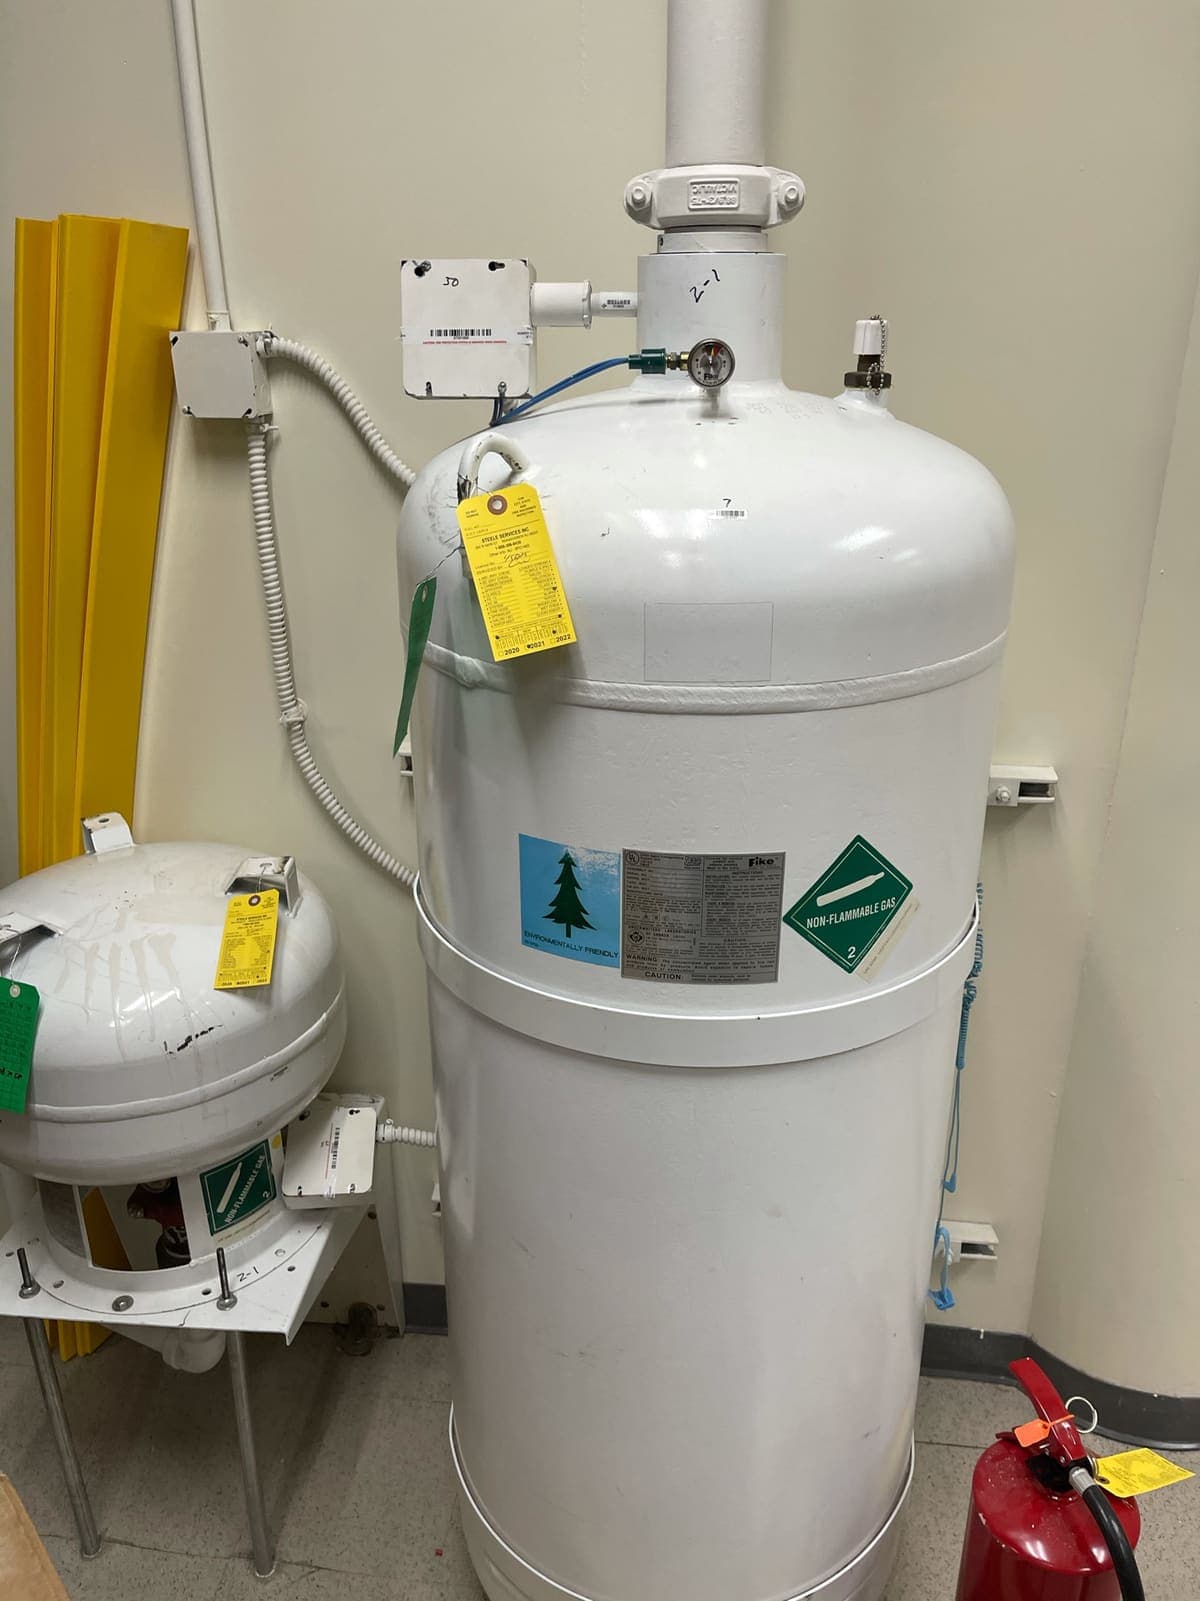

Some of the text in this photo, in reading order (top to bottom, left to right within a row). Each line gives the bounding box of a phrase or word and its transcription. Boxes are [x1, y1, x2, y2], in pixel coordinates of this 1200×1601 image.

[689, 269, 721, 304] 2-1
[722, 498, 732, 508] 7
[504, 647, 520, 656] 2020
[555, 633, 572, 643] 2022
[748, 856, 775, 867] Fike
[806, 896, 896, 929] NON-FLAMMABLE GAS
[584, 946, 620, 959] FRIENDLY
[847, 946, 857, 959] 2
[644, 971, 682, 980] CAUTION
[236, 1266, 260, 1282] 2-1
